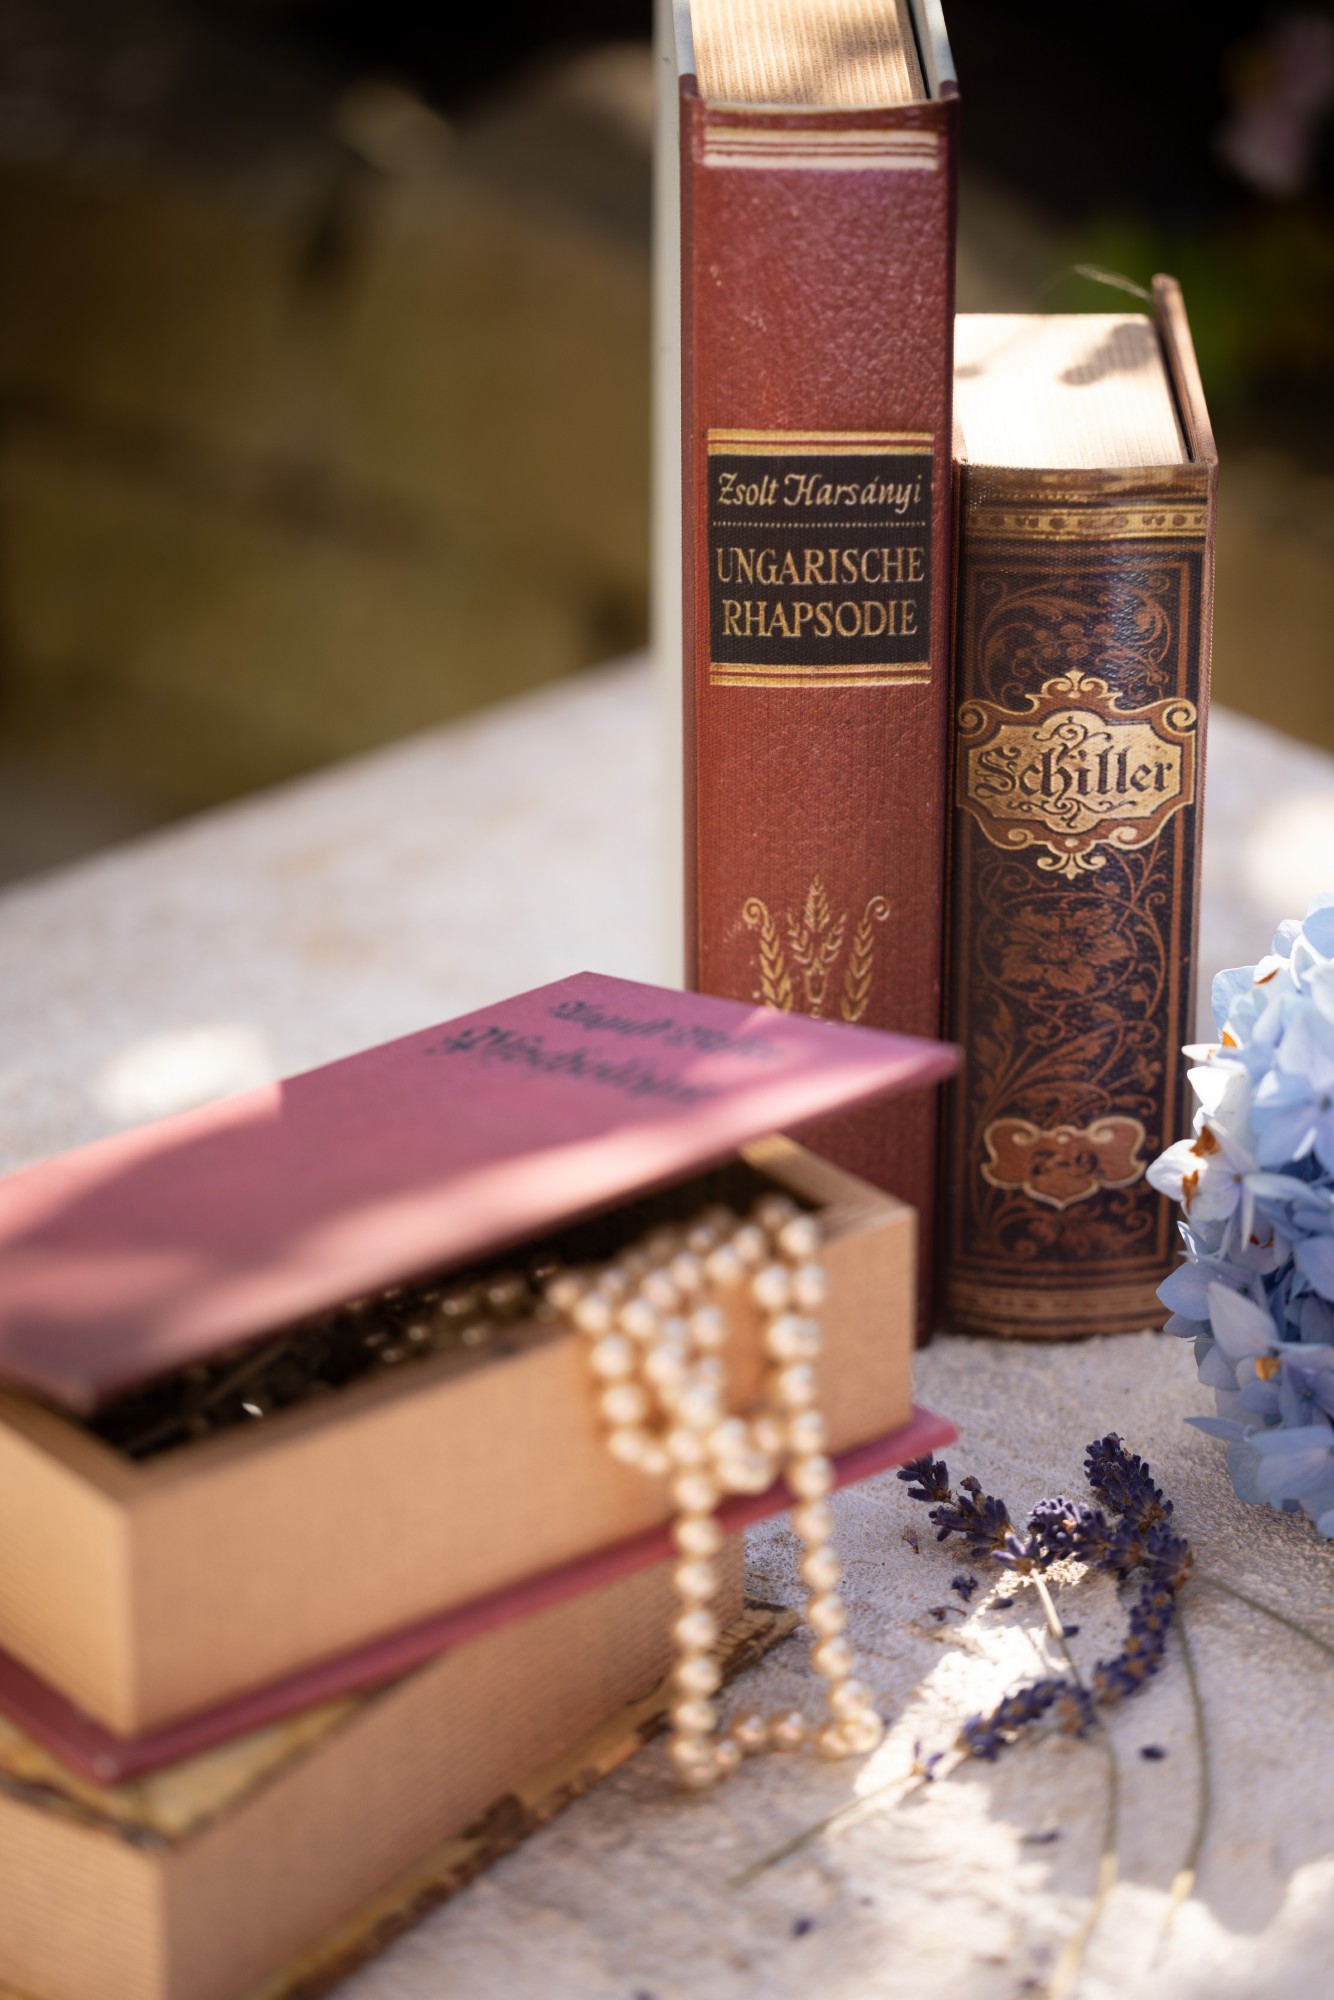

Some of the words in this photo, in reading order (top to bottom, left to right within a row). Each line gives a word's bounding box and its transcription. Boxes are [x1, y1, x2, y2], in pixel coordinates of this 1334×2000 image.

[718, 472, 780, 506] Zsolt
[783, 473, 923, 514] Harsányi
[716, 546, 925, 585] UNGARISCHE
[721, 599, 918, 637] RHAPSODIE
[974, 728, 1173, 812] Schiller
